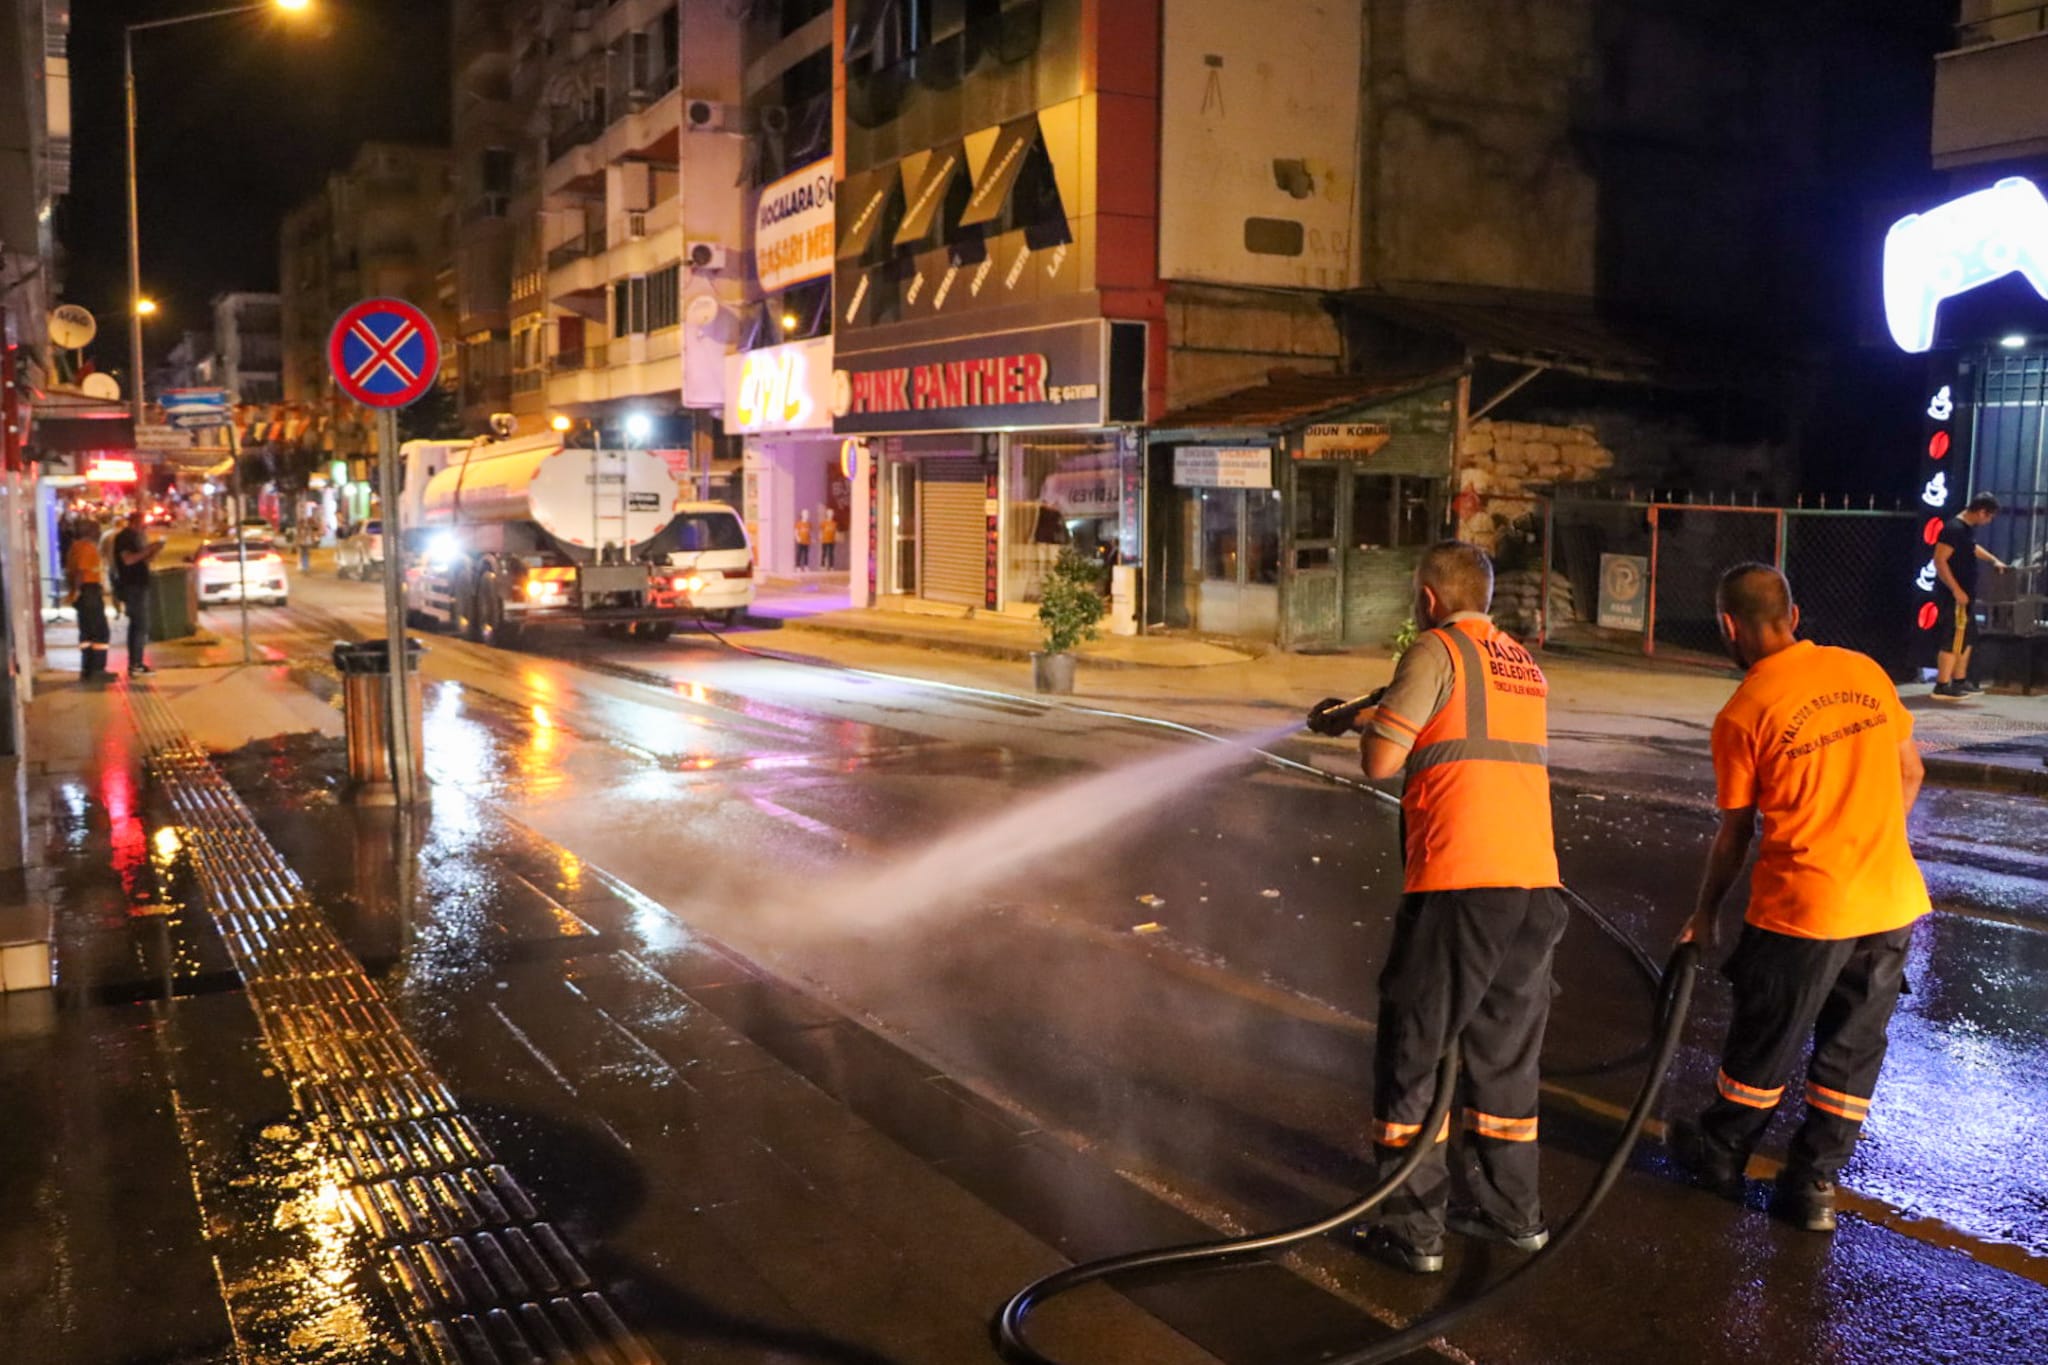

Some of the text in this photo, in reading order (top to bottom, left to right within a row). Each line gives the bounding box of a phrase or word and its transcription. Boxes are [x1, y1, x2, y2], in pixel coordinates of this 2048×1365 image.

[852, 353, 1048, 414] PINK PANTHER
[1781, 705, 1814, 745] YALOVA
